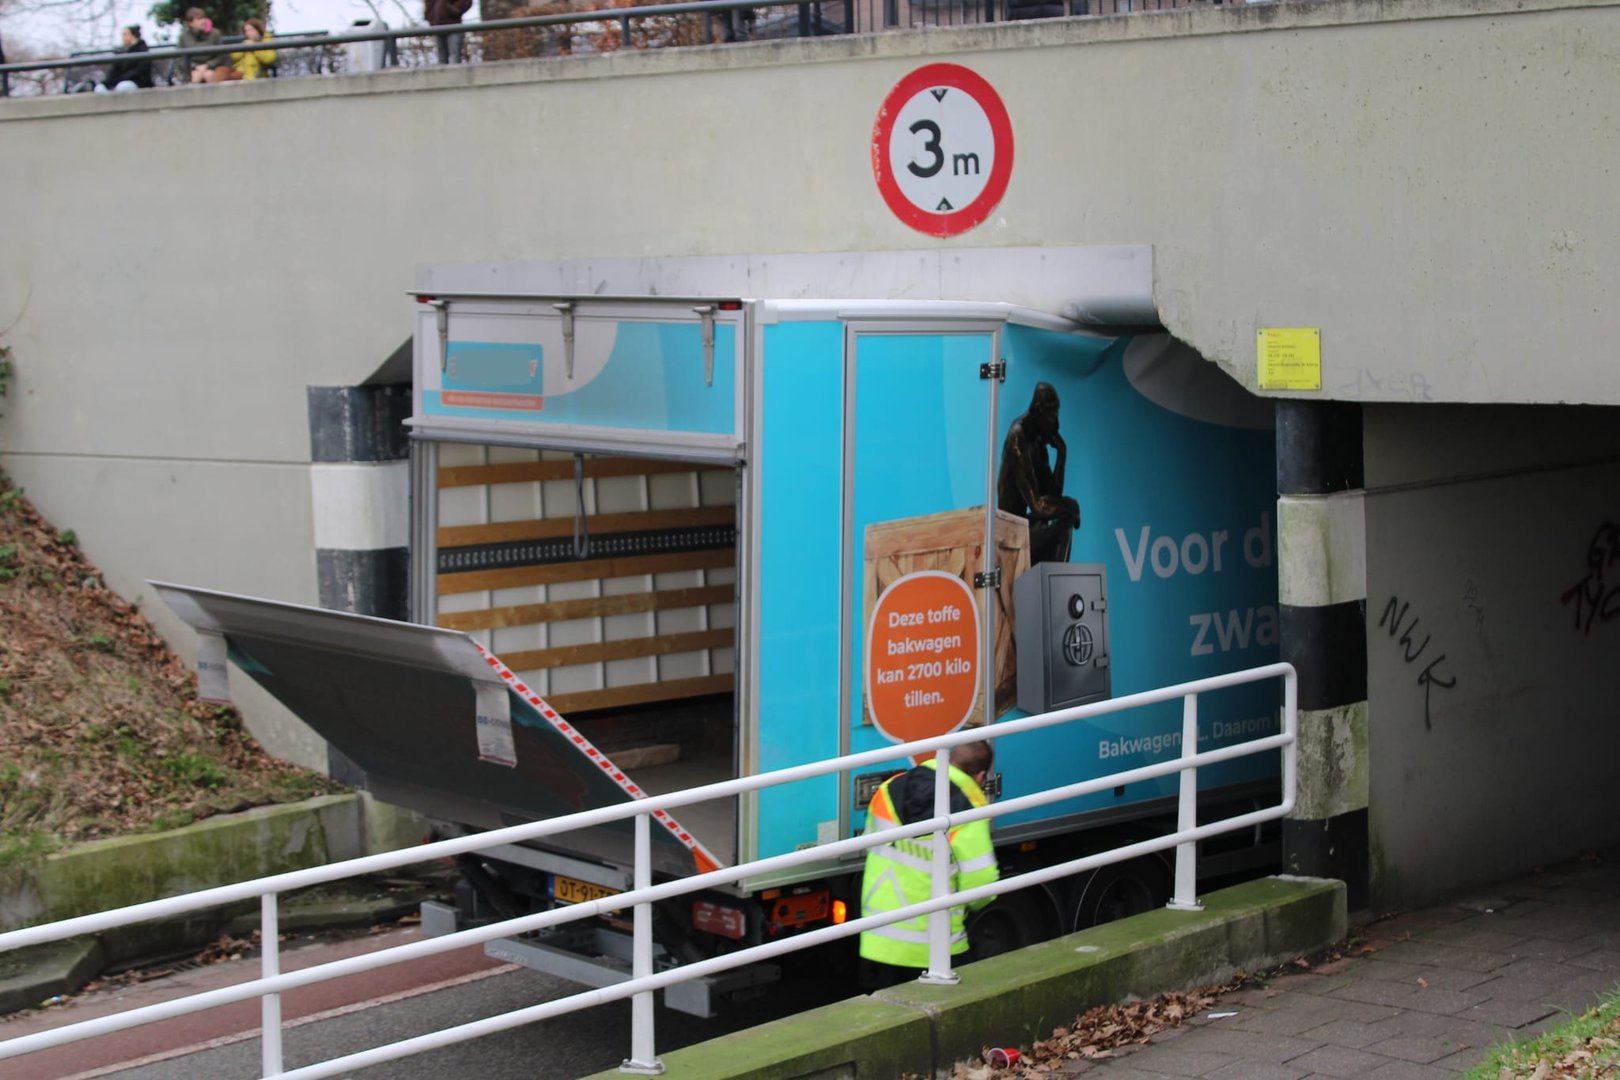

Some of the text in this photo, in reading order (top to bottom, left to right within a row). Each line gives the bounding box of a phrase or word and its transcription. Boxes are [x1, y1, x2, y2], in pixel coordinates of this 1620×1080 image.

[907, 119, 980, 178] 3 m
[1114, 525, 1228, 582] Voor
[889, 605, 961, 628] Deze toffe
[887, 635, 961, 656] bakwagen
[877, 658, 971, 685] kan 2700 kilo
[904, 690, 945, 708] tillen.
[1099, 731, 1182, 760] Bakwagen
[1212, 715, 1271, 739] Daarom
